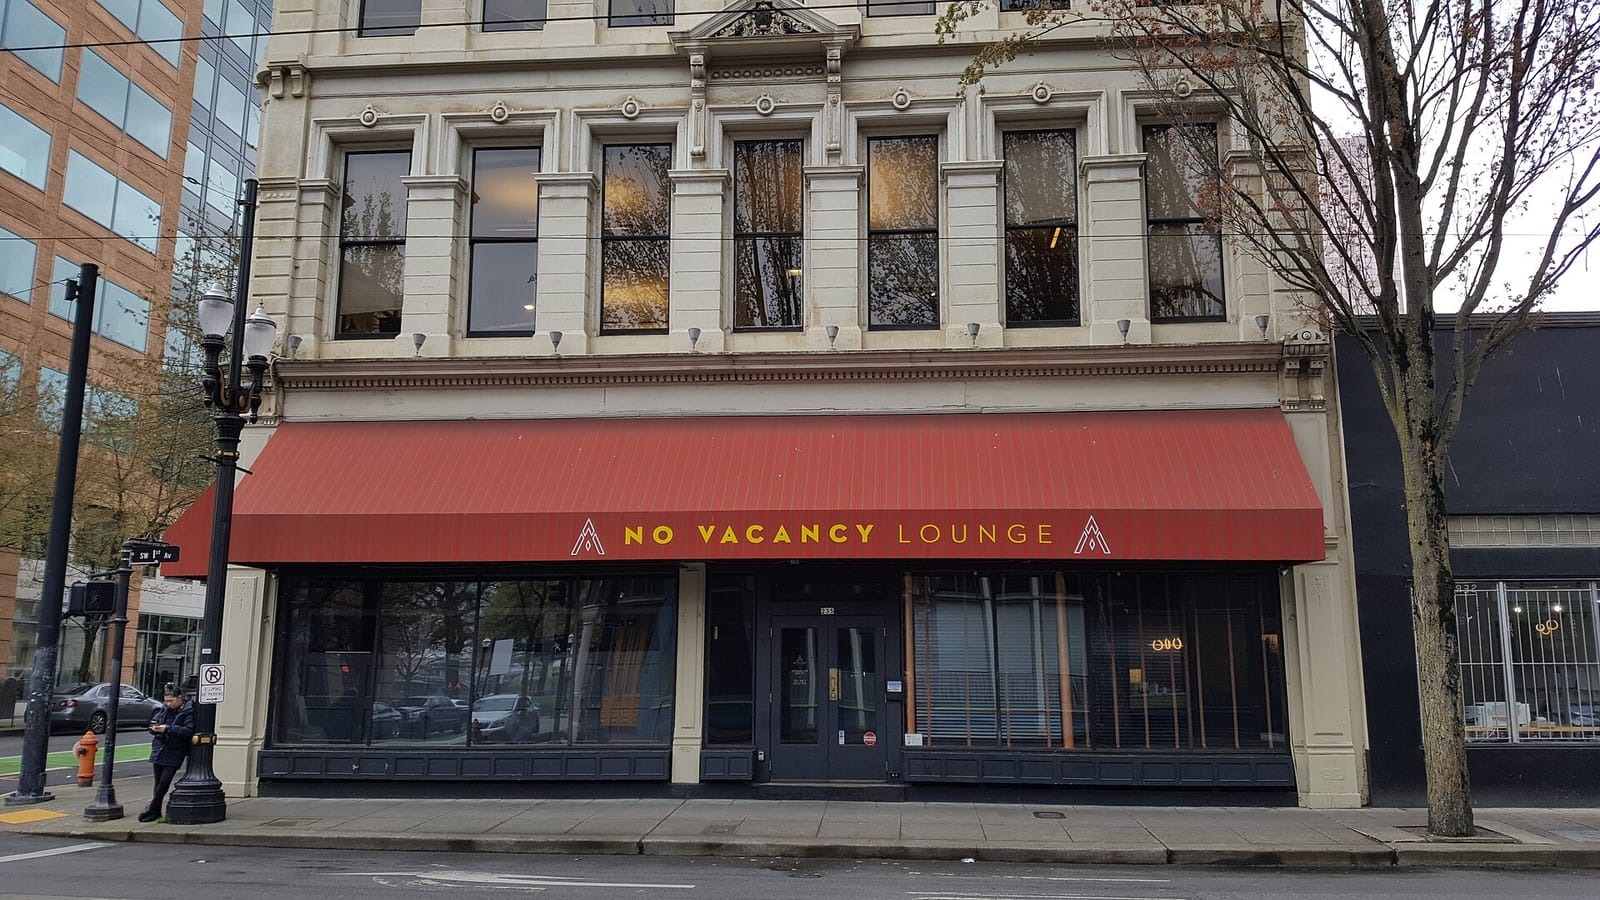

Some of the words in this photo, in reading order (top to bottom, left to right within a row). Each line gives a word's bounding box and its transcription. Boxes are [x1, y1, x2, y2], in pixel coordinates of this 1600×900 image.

[624, 525, 674, 545] NO
[698, 524, 875, 544] VACANCY
[898, 524, 1053, 544] LOUNGE
[139, 552, 150, 560] SW
[163, 551, 172, 559] Av
